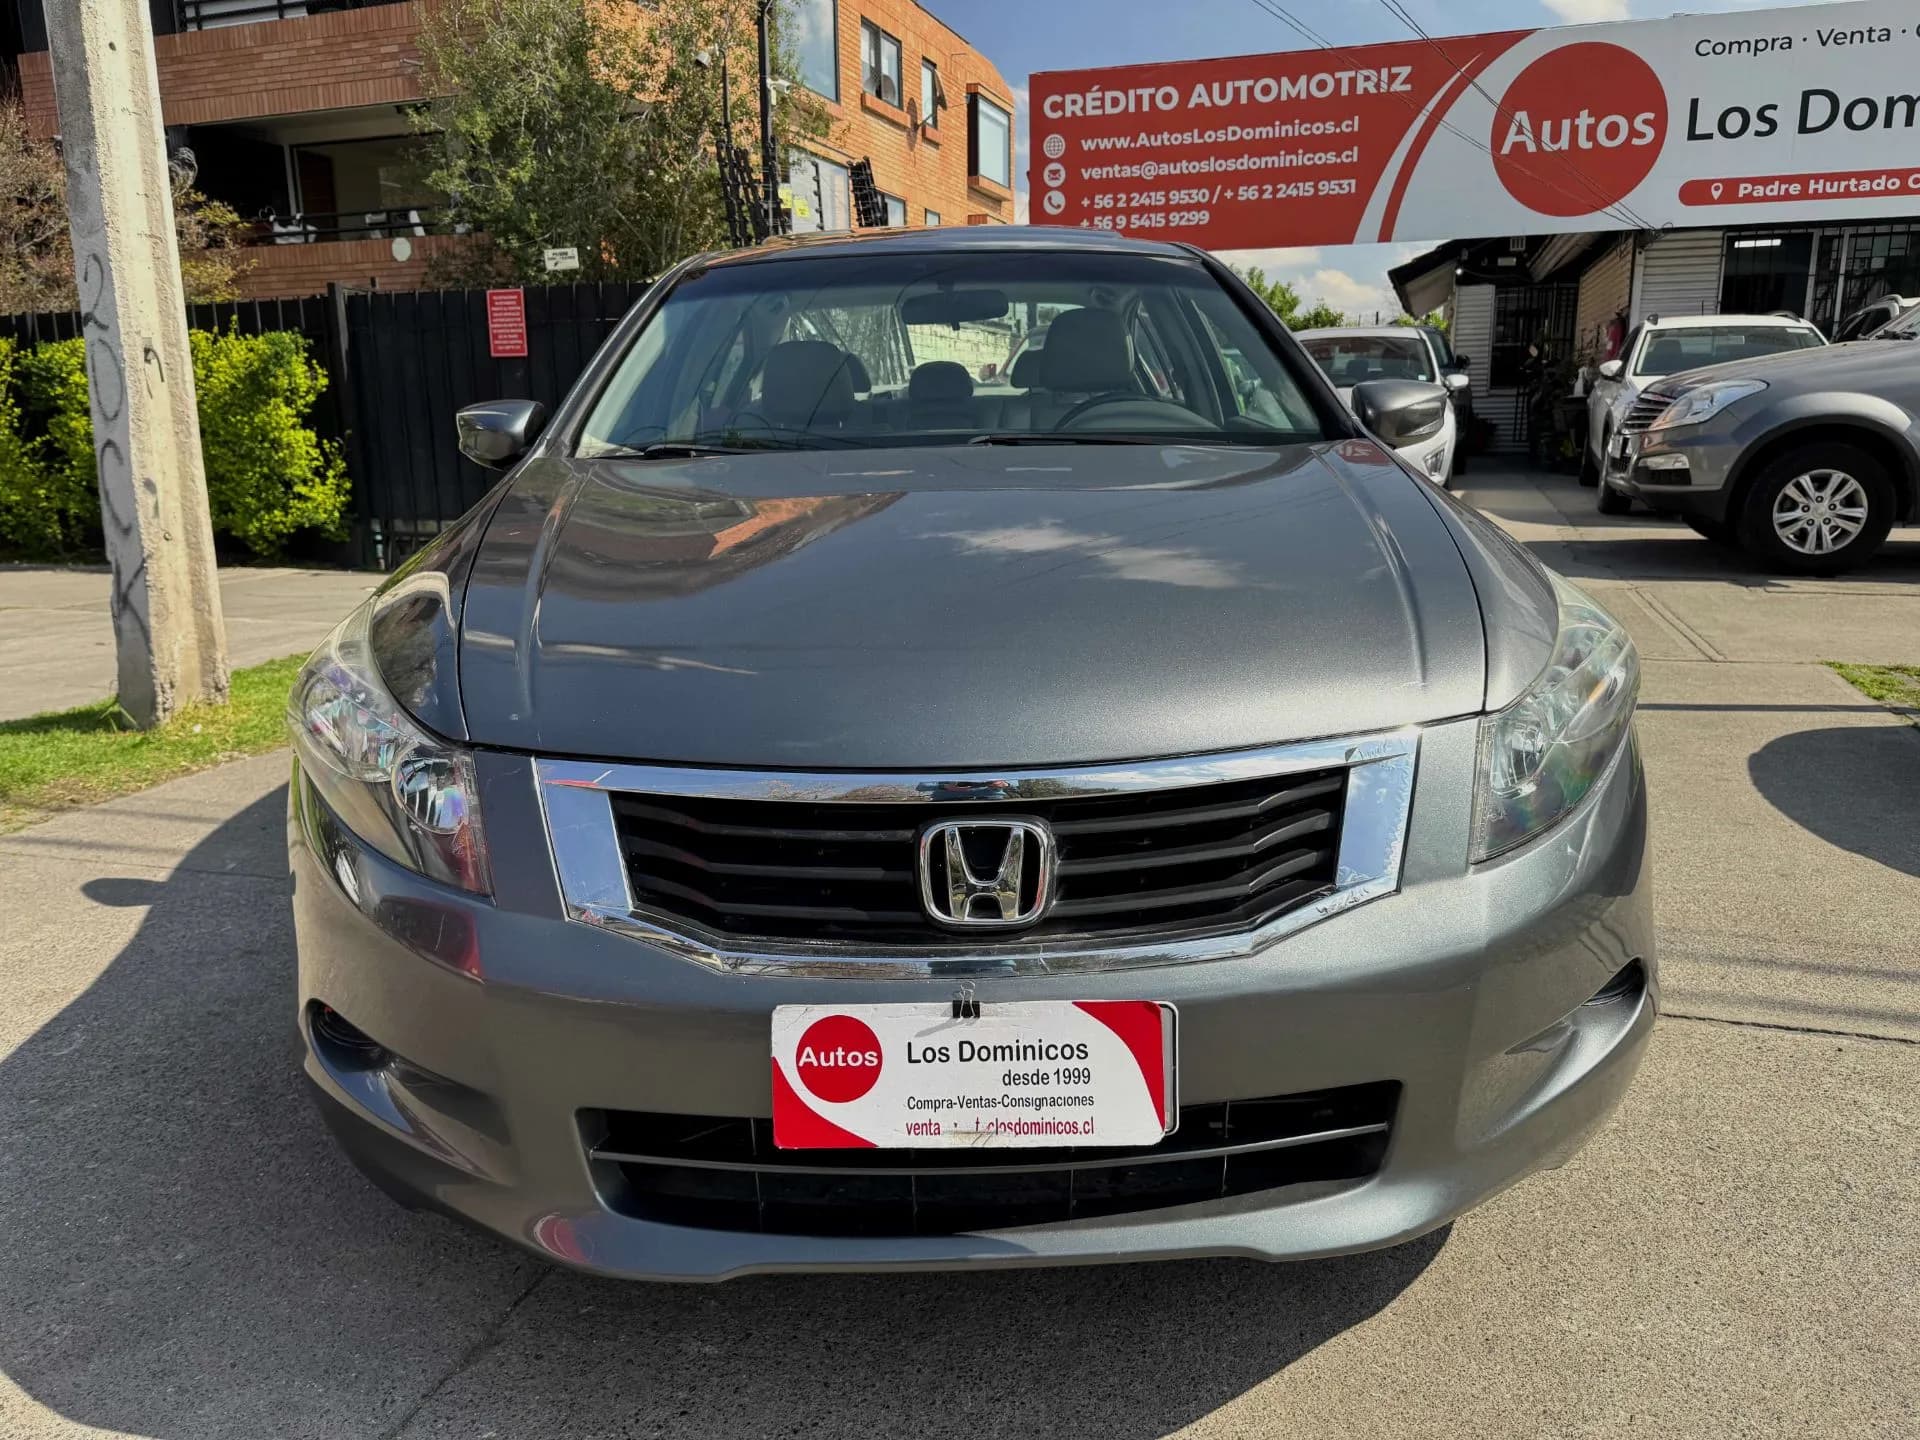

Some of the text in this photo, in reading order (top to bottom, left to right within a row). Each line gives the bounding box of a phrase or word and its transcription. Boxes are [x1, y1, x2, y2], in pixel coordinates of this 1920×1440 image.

[1695, 35, 1793, 57] Compra
[1816, 26, 1891, 47] Venta
[1043, 66, 1412, 119] CRÉDITO AUTOMOTRIZ
[1080, 116, 1359, 151] www.AutosLosDominicos.cl
[1500, 109, 1656, 155] Autos
[1687, 98, 1779, 141] Los
[1080, 146, 1358, 180] ventas@autoslosdominicos.cl
[1094, 194, 1114, 209] 56
[1117, 193, 1127, 208] 2
[1130, 191, 1166, 207] 2415
[1169, 188, 1209, 205] 9530
[1237, 185, 1259, 200] 56
[1262, 184, 1273, 199] 2
[1276, 181, 1314, 199] 2415
[1318, 179, 1357, 196] 9531
[1738, 180, 1801, 198] Padre
[1808, 175, 1900, 194] Hurtado
[1093, 215, 1113, 230] 56
[1116, 215, 1127, 229] 9
[1129, 213, 1166, 229] 5415
[1169, 210, 1209, 226] 9299
[798, 1046, 879, 1067] Autos
[907, 1038, 1089, 1064] Los Dominicos
[1002, 1067, 1091, 1086] desde 1999
